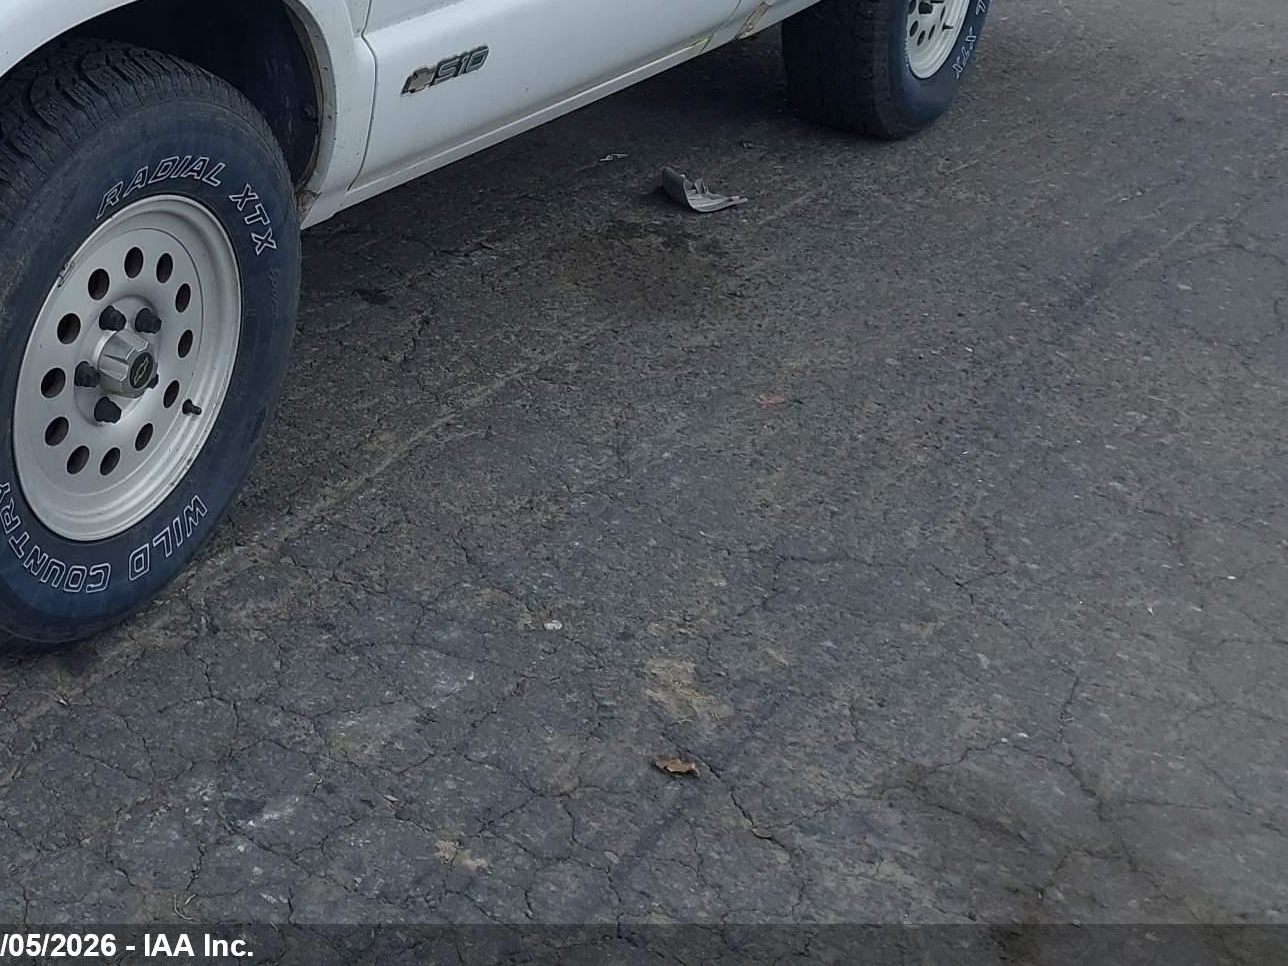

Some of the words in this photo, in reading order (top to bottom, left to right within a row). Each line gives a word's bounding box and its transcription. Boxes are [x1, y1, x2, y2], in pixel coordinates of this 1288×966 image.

[96, 155, 226, 220] RADIAL
[228, 183, 278, 256] XTX
[128, 495, 208, 581] WILD
